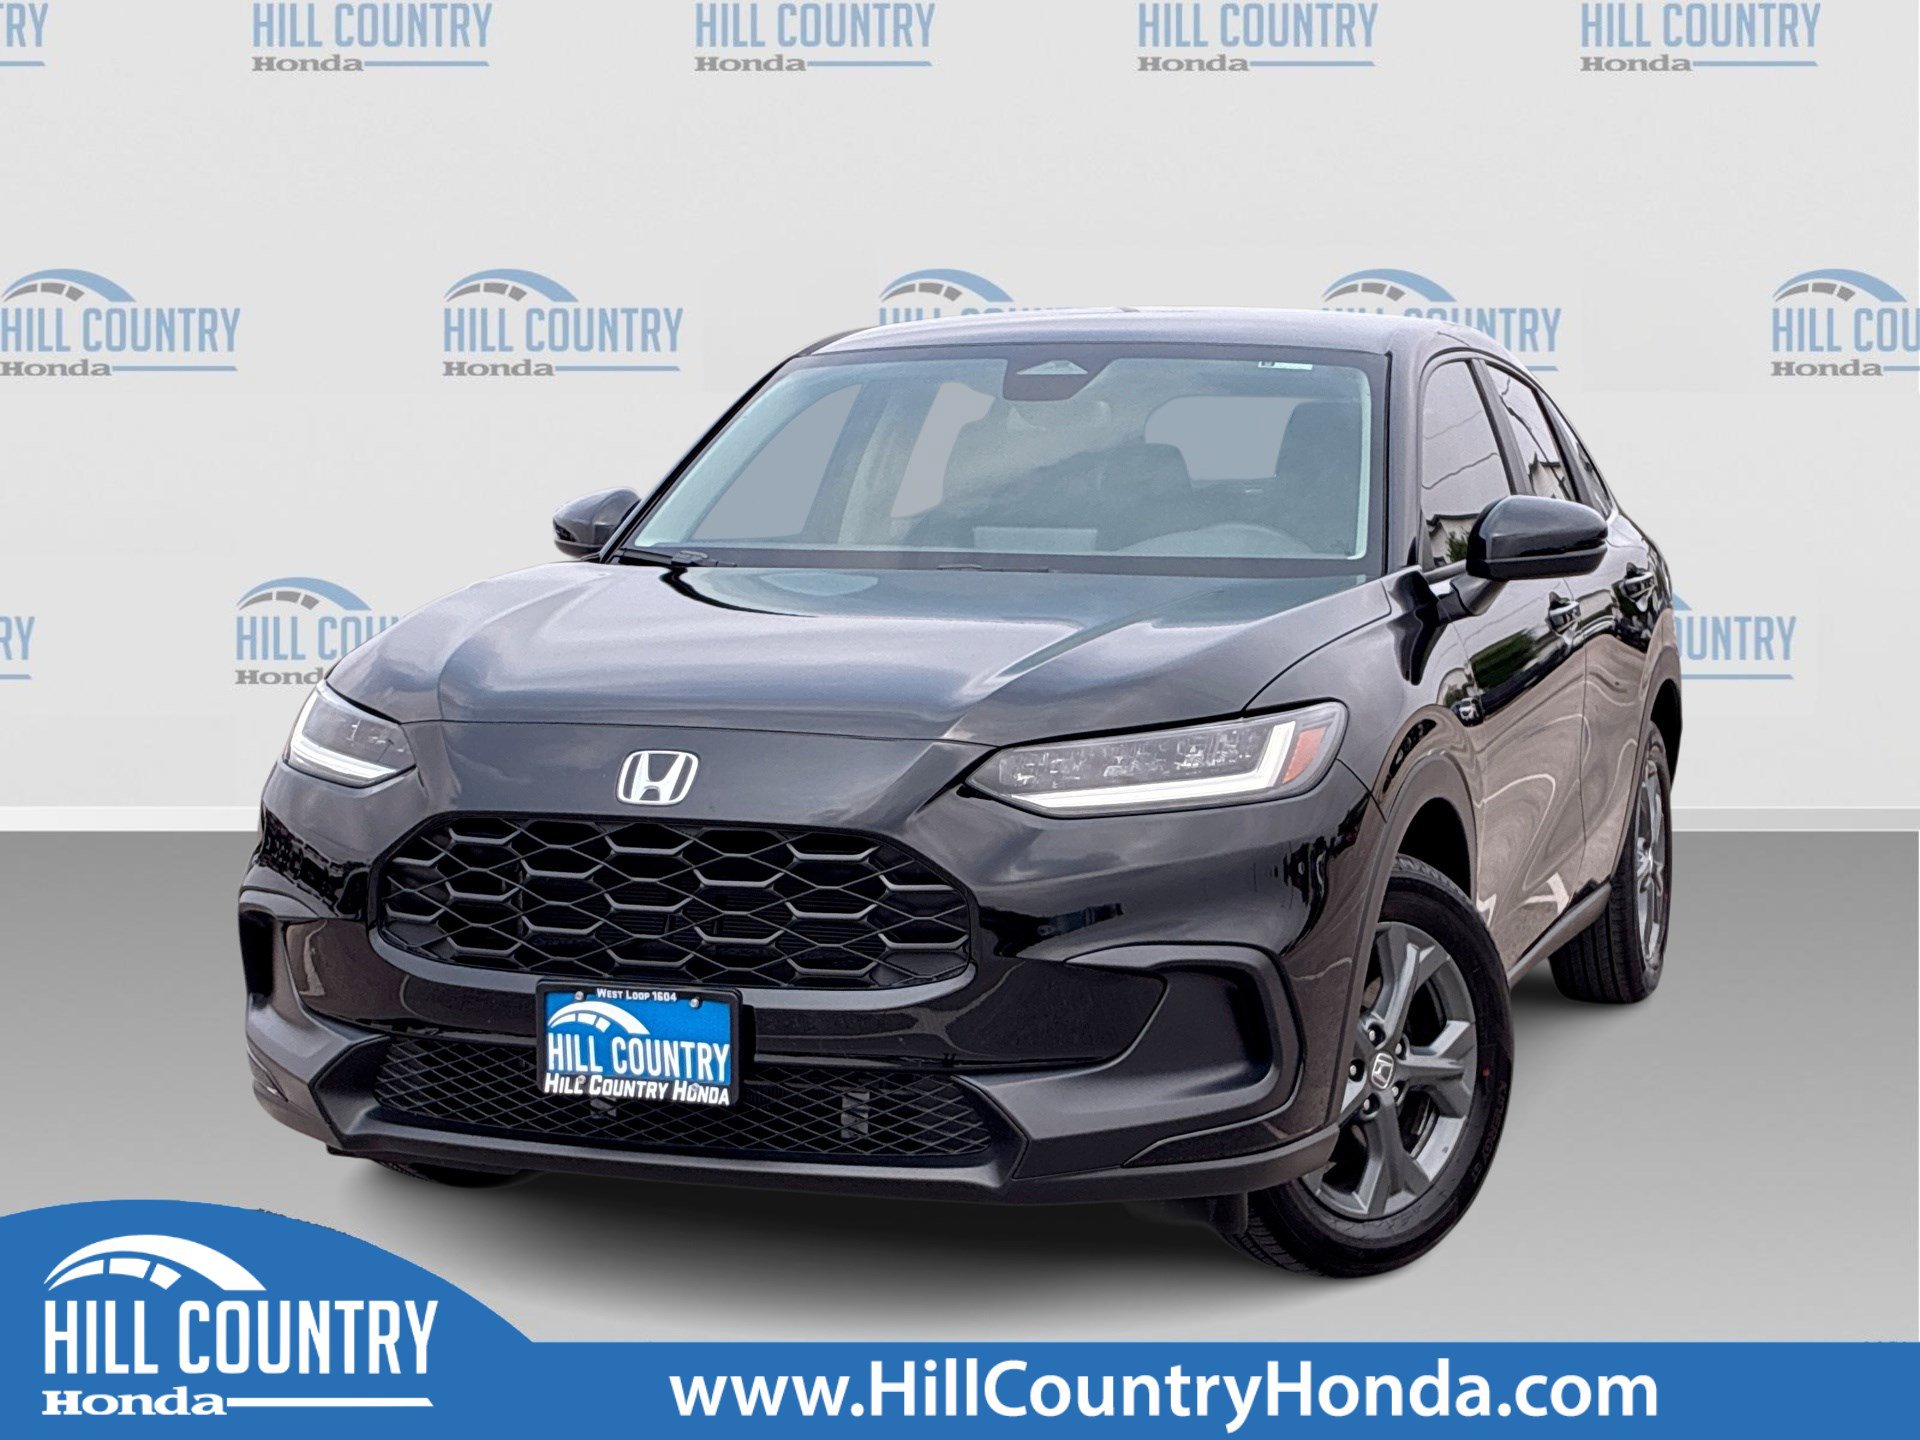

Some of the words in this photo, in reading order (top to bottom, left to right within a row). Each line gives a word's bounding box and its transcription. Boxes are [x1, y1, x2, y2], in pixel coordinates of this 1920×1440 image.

[252, 3, 321, 47] HILL
[334, 2, 492, 48] COUNTRY
[695, 3, 764, 47] HILL
[777, 2, 935, 48] COUNTRY
[1138, 3, 1207, 47] HILL
[1220, 2, 1378, 48] COUNTRY
[1581, 3, 1650, 47] HILL
[1663, 2, 1821, 48] COUNTRY
[251, 54, 364, 72] Honda
[694, 54, 807, 72] Honda
[1137, 54, 1250, 72] Honda
[1580, 54, 1693, 72] Honda
[0, 308, 69, 352] HILL
[82, 307, 241, 353] COUNTRY
[443, 308, 512, 352] HILL
[525, 307, 683, 353] COUNTRY
[1772, 308, 1842, 352] HILL
[0, 359, 112, 377] Honda
[442, 359, 554, 377] Honda
[1770, 359, 1883, 377] Honda
[236, 616, 306, 661] HILL
[652, 991, 677, 1002] 1604
[548, 1032, 603, 1073] HILL
[612, 1036, 730, 1083] COUNTRY
[544, 1072, 584, 1095] HILL
[589, 1075, 669, 1100] COUNTRY
